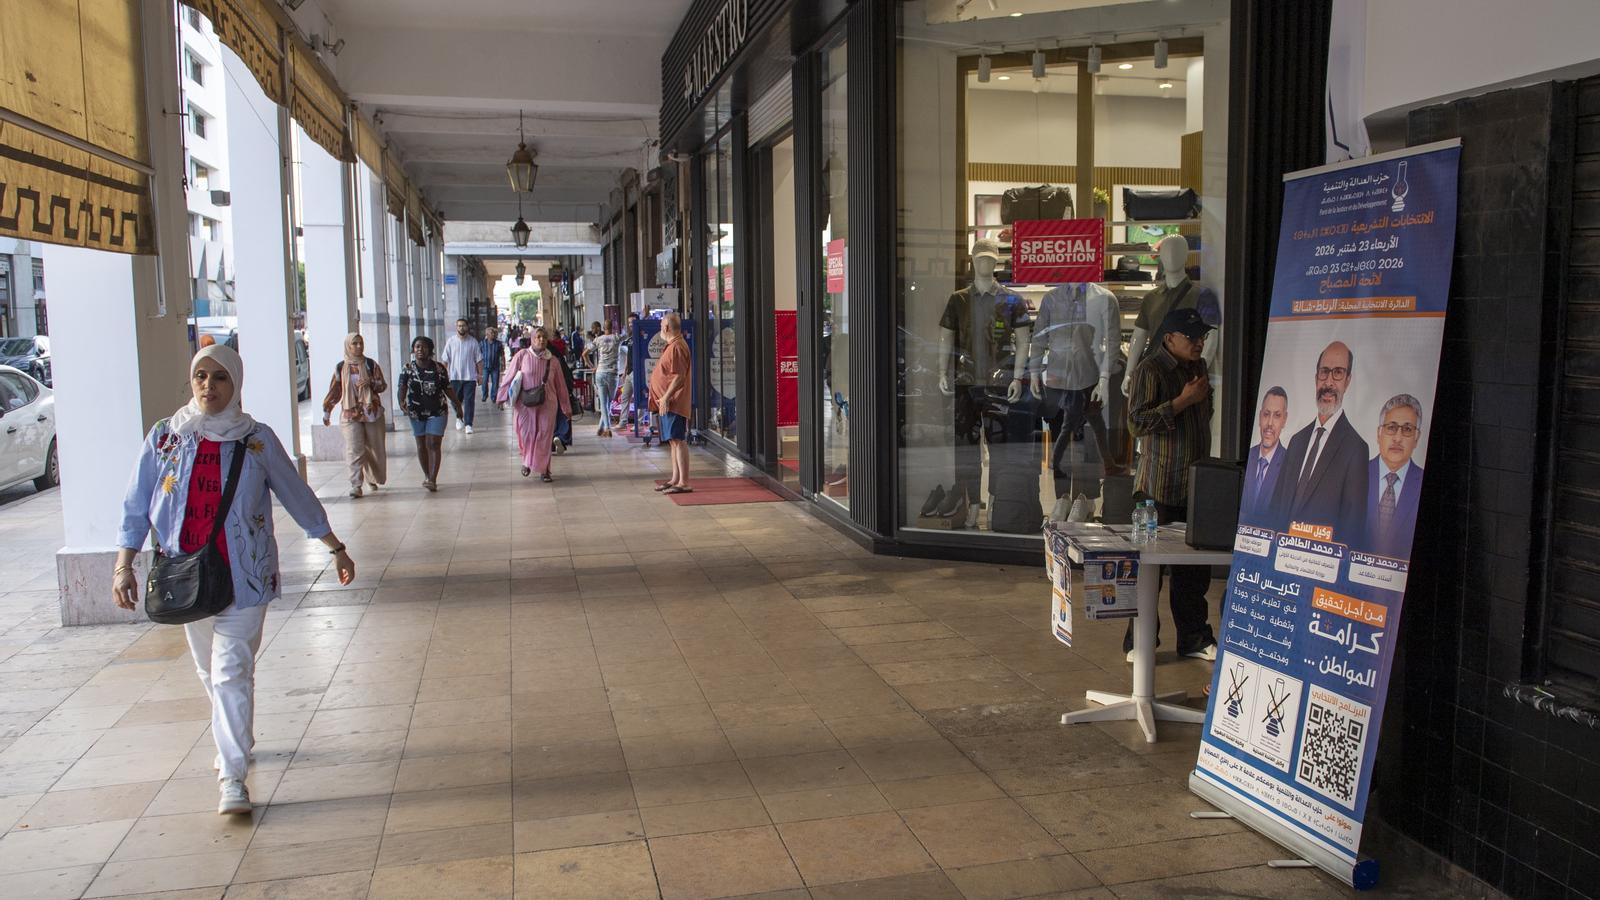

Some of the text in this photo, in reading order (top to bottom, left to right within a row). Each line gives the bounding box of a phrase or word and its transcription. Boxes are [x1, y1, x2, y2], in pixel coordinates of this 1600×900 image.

[694, 0, 747, 103] MAESTRO
[1323, 173, 1390, 193] حزب العدالة والتنمية
[1351, 216, 1389, 234] التشريعية
[1391, 210, 1434, 228] الانتخابات
[1020, 239, 1096, 254] SPECIAL
[1315, 235, 1399, 256] الأربعاء 23 شتنبر 2026
[1020, 253, 1095, 264] PROMOTION
[1329, 263, 1340, 274] 23
[1378, 258, 1404, 269] 2026
[1319, 272, 1382, 294] لائحة المصباح
[1292, 520, 1331, 539] وكيل اللائحة
[1311, 543, 1334, 555] محمد
[1376, 559, 1398, 569] محمد
[1236, 568, 1300, 596] تكريس الحق
[1234, 586, 1297, 614] في تعليم ذي جودة
[1316, 593, 1383, 623] من أجل تحقيق
[1231, 603, 1294, 632] وتغطية صحية فعلية
[1228, 618, 1292, 649] وشغل لائق
[1308, 612, 1384, 655] كرامة
[1225, 634, 1289, 666] ومجتمع متضامن
[1319, 655, 1377, 688] المواطن
[1312, 690, 1366, 718] البرنامج الانتخابي
[1276, 784, 1295, 801] والتنمية
[1295, 796, 1312, 809] العدالة
[1312, 806, 1322, 815] حزب
